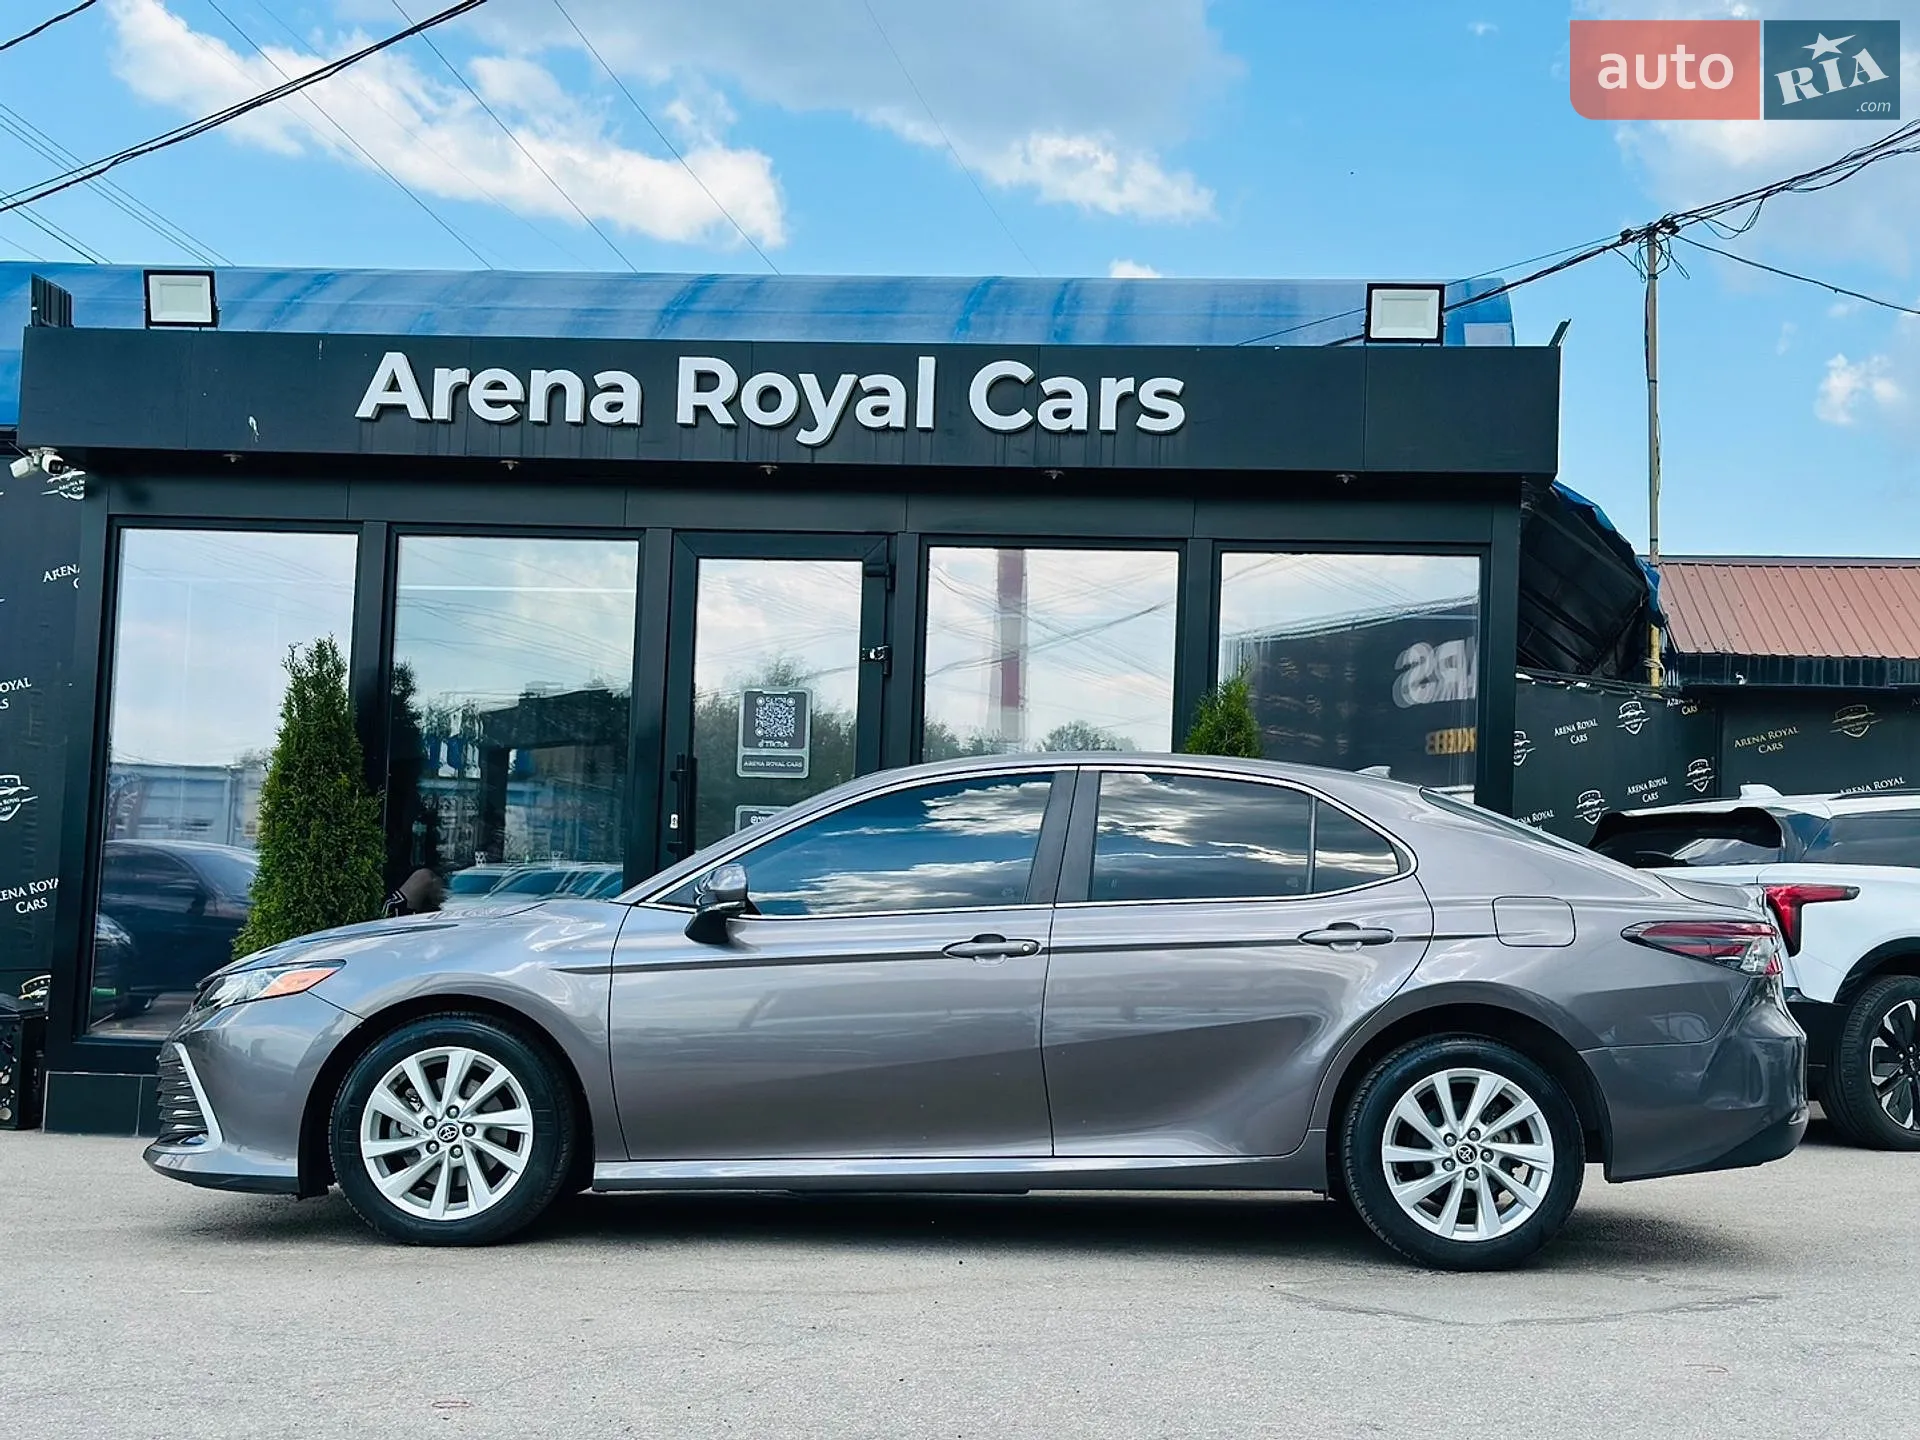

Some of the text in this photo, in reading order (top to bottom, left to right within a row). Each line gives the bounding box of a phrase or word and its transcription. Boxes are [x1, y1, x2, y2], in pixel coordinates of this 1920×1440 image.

[355, 351, 1186, 448] Arena Royal Cars
[0, 676, 32, 694] OYAL
[1554, 718, 1599, 737] ARENA ROYAL
[1570, 733, 1588, 745] CARS
[1734, 726, 1800, 748] ARENA ROYAL
[1758, 741, 1784, 755] CARS
[1873, 776, 1906, 790] ROYAL
[1642, 791, 1659, 803] CARS
[15, 897, 48, 914] CARS
